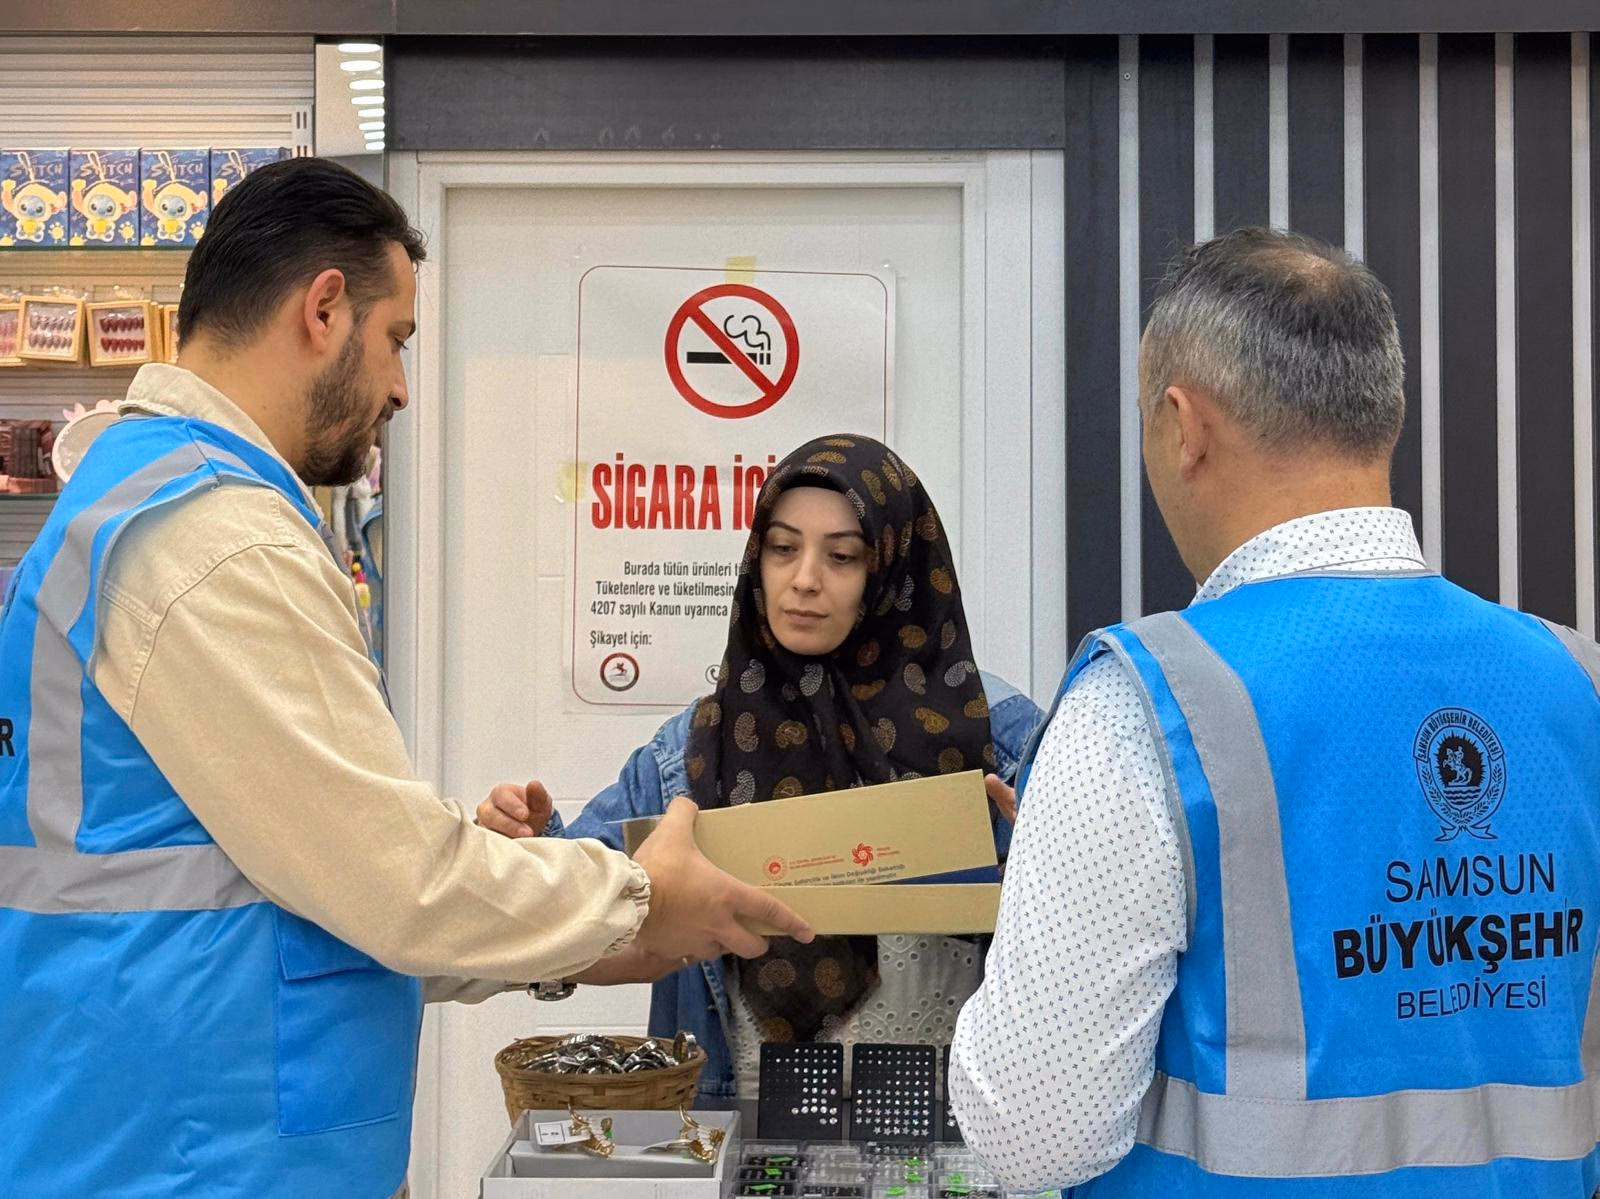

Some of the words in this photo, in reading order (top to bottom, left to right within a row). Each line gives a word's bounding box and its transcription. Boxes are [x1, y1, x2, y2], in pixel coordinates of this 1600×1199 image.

[592, 453, 722, 529] SİGARA
[595, 581, 655, 595] Tüketenlere
[658, 584, 670, 595] ve
[624, 561, 660, 576] Burada
[664, 561, 689, 576] tütün
[692, 561, 732, 577] ürünleri
[590, 600, 616, 615] 4207
[619, 601, 646, 618] sayılı
[649, 601, 681, 616] Kanun
[684, 603, 728, 619] uyarınca
[590, 630, 627, 648] Şikayet
[630, 630, 653, 649] için:
[1417, 729, 1433, 759] SAMSUN
[1467, 716, 1501, 756] BELEDİYESİ
[1386, 853, 1555, 903] SAMSUN
[1332, 897, 1583, 979] BÜYÜKŞEHİR
[1397, 974, 1547, 1020] BELEDİYESİ
